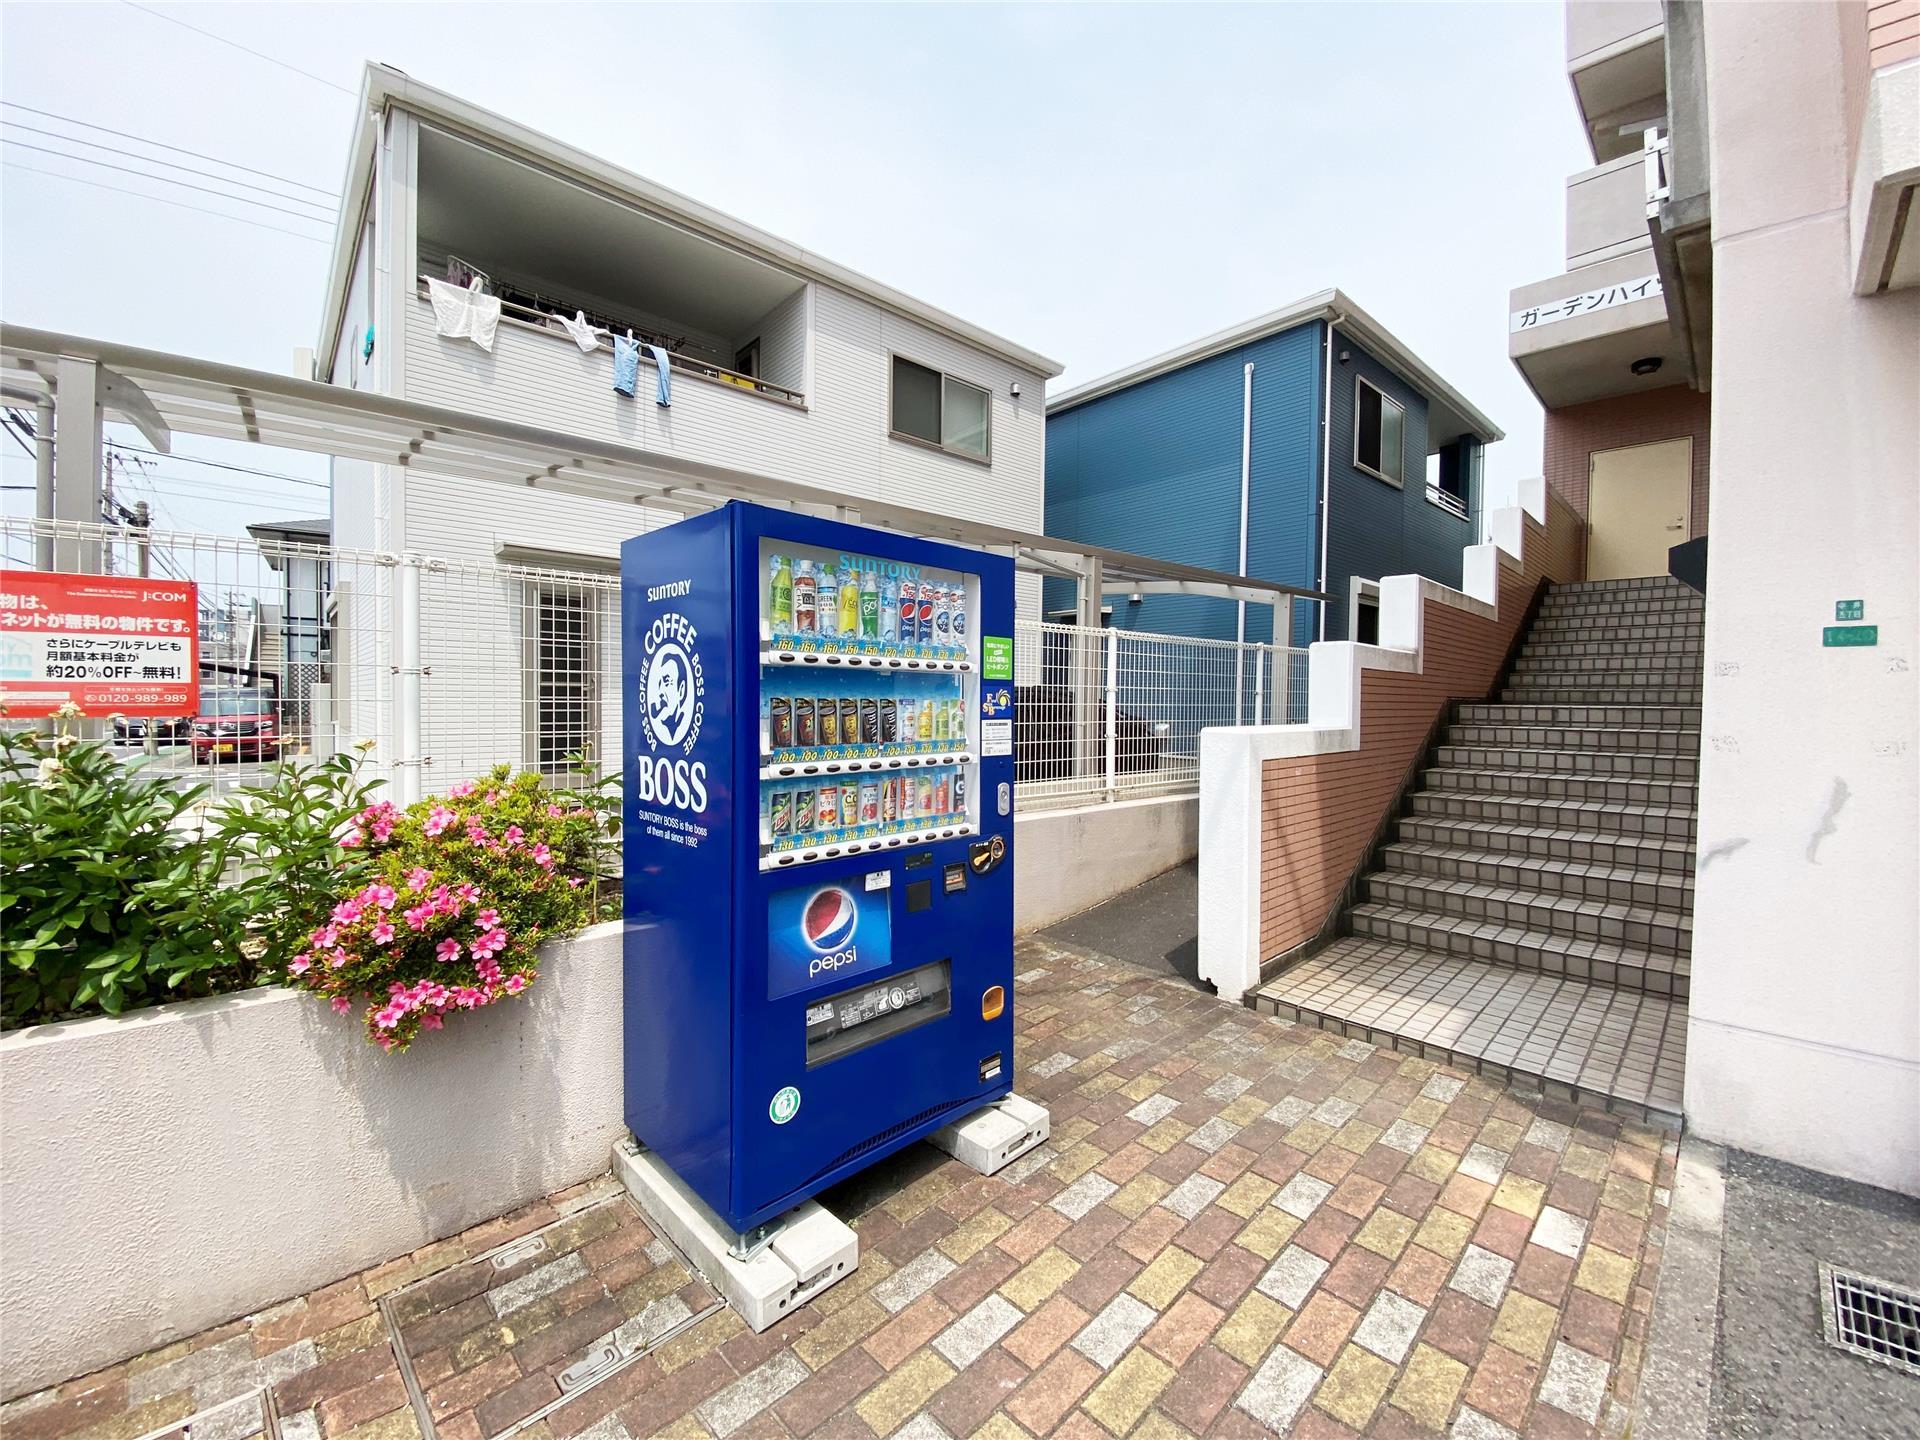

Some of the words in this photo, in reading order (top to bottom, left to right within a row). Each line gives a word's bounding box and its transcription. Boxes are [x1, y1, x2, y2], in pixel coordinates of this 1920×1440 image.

[648, 579, 691, 602] SUNTORY
[0, 594, 48, 610] 物は、
[1, 611, 191, 633] ネットが無料の物件です。
[46, 638, 182, 652] さらにケーブルテレビも
[645, 613, 698, 655] COFFEE
[46, 651, 140, 663] 月額基本料金が
[639, 657, 649, 714] COFFEE
[692, 653, 704, 697] BOSS
[98, 694, 187, 703] 0120-989-989
[642, 716, 657, 752] BOSS
[683, 702, 704, 756] COFFEE
[778, 752, 795, 762] 100
[801, 751, 818, 761] 100
[823, 750, 839, 760] 100
[844, 749, 859, 759] 100
[863, 747, 878, 757] 100
[887, 746, 900, 756] 100
[638, 755, 707, 813] BOSS
[639, 809, 663, 825] SUNTORY
[663, 815, 679, 829] BOSS
[685, 821, 693, 833] the
[694, 823, 707, 837] boss
[652, 826, 663, 838] them
[671, 831, 684, 844] since
[685, 836, 698, 848] 1992
[809, 945, 857, 978] pepsi
